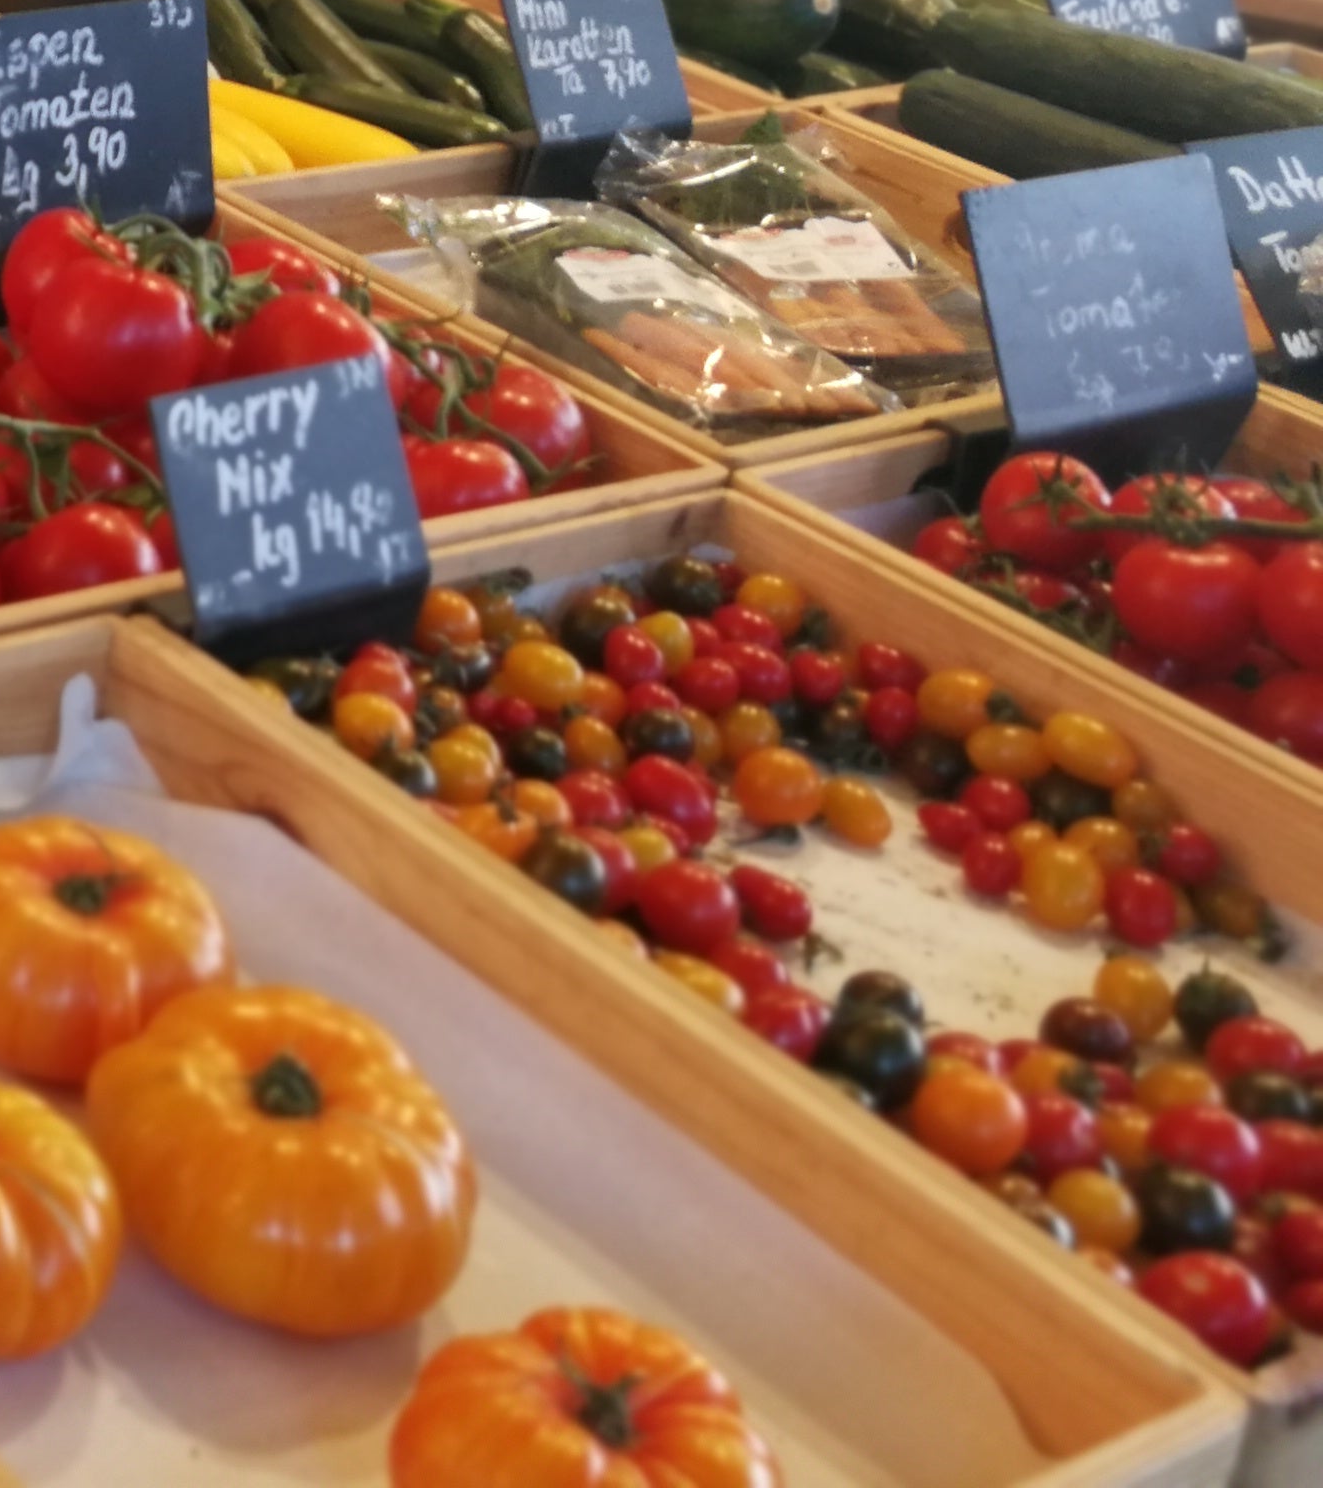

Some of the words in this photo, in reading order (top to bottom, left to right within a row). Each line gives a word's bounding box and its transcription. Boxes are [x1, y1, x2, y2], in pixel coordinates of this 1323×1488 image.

[55, 125, 128, 200] 3,90
[1226, 155, 1323, 213] Datt
[167, 377, 320, 457] Cherry
[215, 447, 295, 517] Mix
[251, 511, 302, 589] kg
